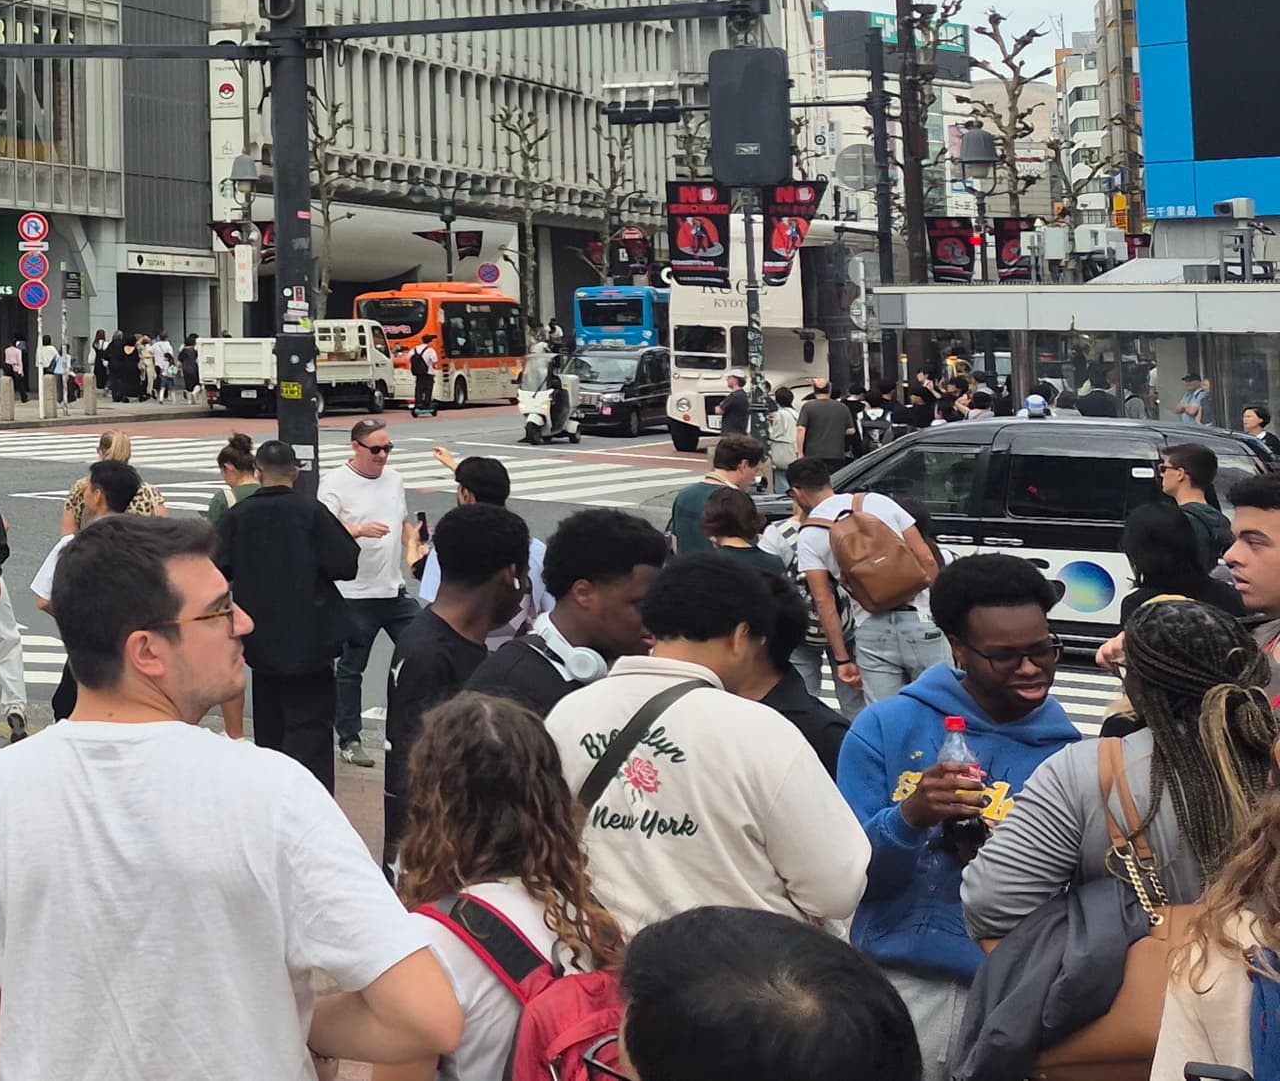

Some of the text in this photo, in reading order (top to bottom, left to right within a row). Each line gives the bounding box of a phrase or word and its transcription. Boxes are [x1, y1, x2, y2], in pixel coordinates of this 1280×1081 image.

[713, 298, 747, 309] KYOT
[580, 726, 687, 764] Brolyn
[592, 806, 700, 840] New York
